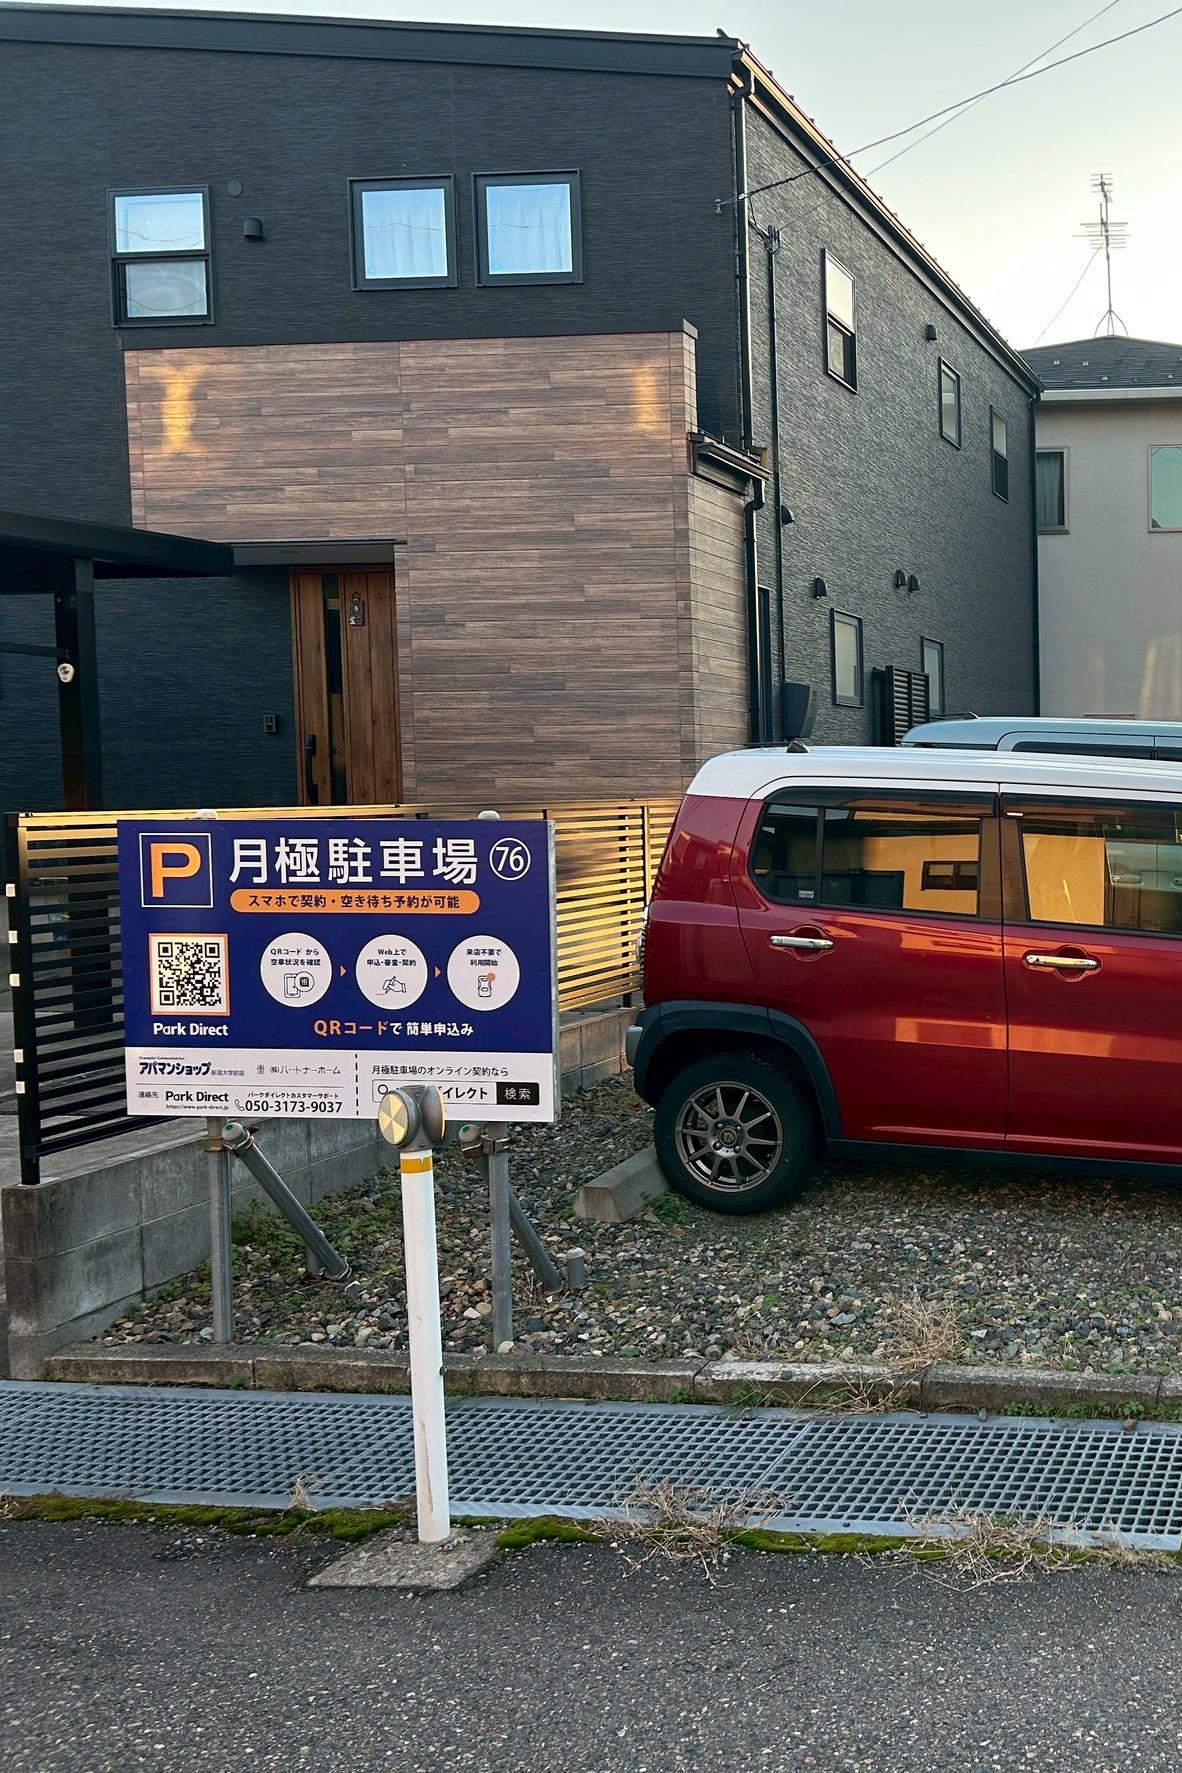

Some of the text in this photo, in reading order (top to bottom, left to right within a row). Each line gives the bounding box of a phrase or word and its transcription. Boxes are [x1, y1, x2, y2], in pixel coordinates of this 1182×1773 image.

[229, 837, 527, 884] 月極駐車場 76
[150, 842, 202, 898] P
[248, 894, 460, 909] スマホで契約・空き待ち予約が可能
[270, 958, 321, 966] 空車状況を確認
[470, 959, 498, 967] 利用開始
[153, 1022, 229, 1036] Park Direct
[406, 1021, 474, 1037] 簡単申込み
[139, 1061, 212, 1076] アパマンショップ
[371, 1064, 509, 1077] 月極駐車場のオンライン契約なら
[165, 1090, 229, 1102] Park Direct
[438, 1086, 488, 1100] イレクト
[504, 1087, 531, 1100] 検索
[245, 1100, 343, 1113] 050-3173-9037
